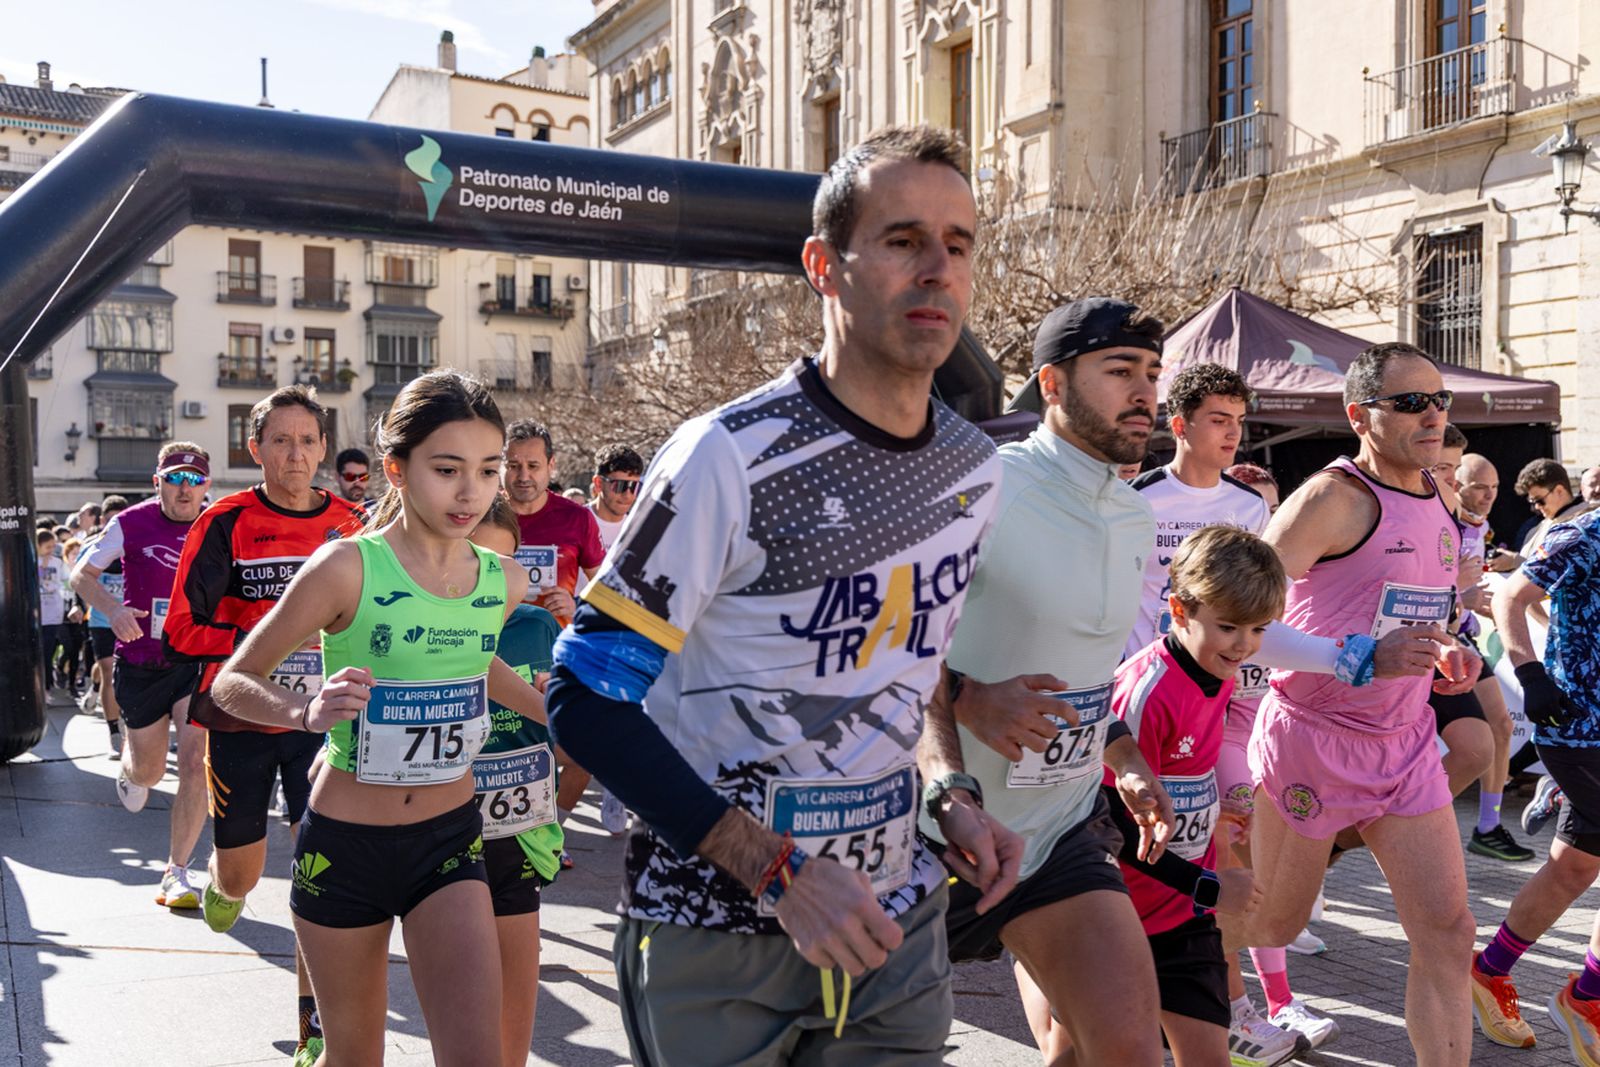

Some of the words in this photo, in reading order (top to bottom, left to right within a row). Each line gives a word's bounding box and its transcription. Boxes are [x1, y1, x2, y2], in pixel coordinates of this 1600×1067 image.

[460, 166, 551, 192] Patronato
[556, 176, 642, 203] Municipal
[647, 186, 670, 204] de
[459, 188, 546, 212] Deportes
[550, 199, 575, 216] de
[578, 201, 623, 221] Jaén
[18, 505, 28, 516] de
[1156, 534, 1188, 547] BUEN
[242, 566, 275, 580] CLUB
[280, 566, 293, 578] DE
[1392, 603, 1416, 616] BUENA
[1417, 606, 1440, 617] MUERTE
[428, 627, 478, 637] Fundación
[427, 636, 465, 648] Unicaja
[269, 675, 307, 694] 56
[385, 691, 395, 700] VI
[397, 690, 440, 701] CARRERA
[383, 705, 421, 720] BUENA
[425, 702, 466, 720] MUERTE
[403, 723, 463, 762] 715
[1044, 725, 1096, 765] 672
[501, 755, 539, 770] CAMINATA
[486, 770, 524, 788] MUERTE
[796, 793, 808, 805] VI
[810, 789, 864, 805] CARRERA
[866, 775, 904, 800] CAMINATA
[792, 810, 840, 831] BUENA
[843, 800, 888, 828] MUERTE
[1169, 808, 1211, 842] 264
[817, 826, 887, 873] 655
